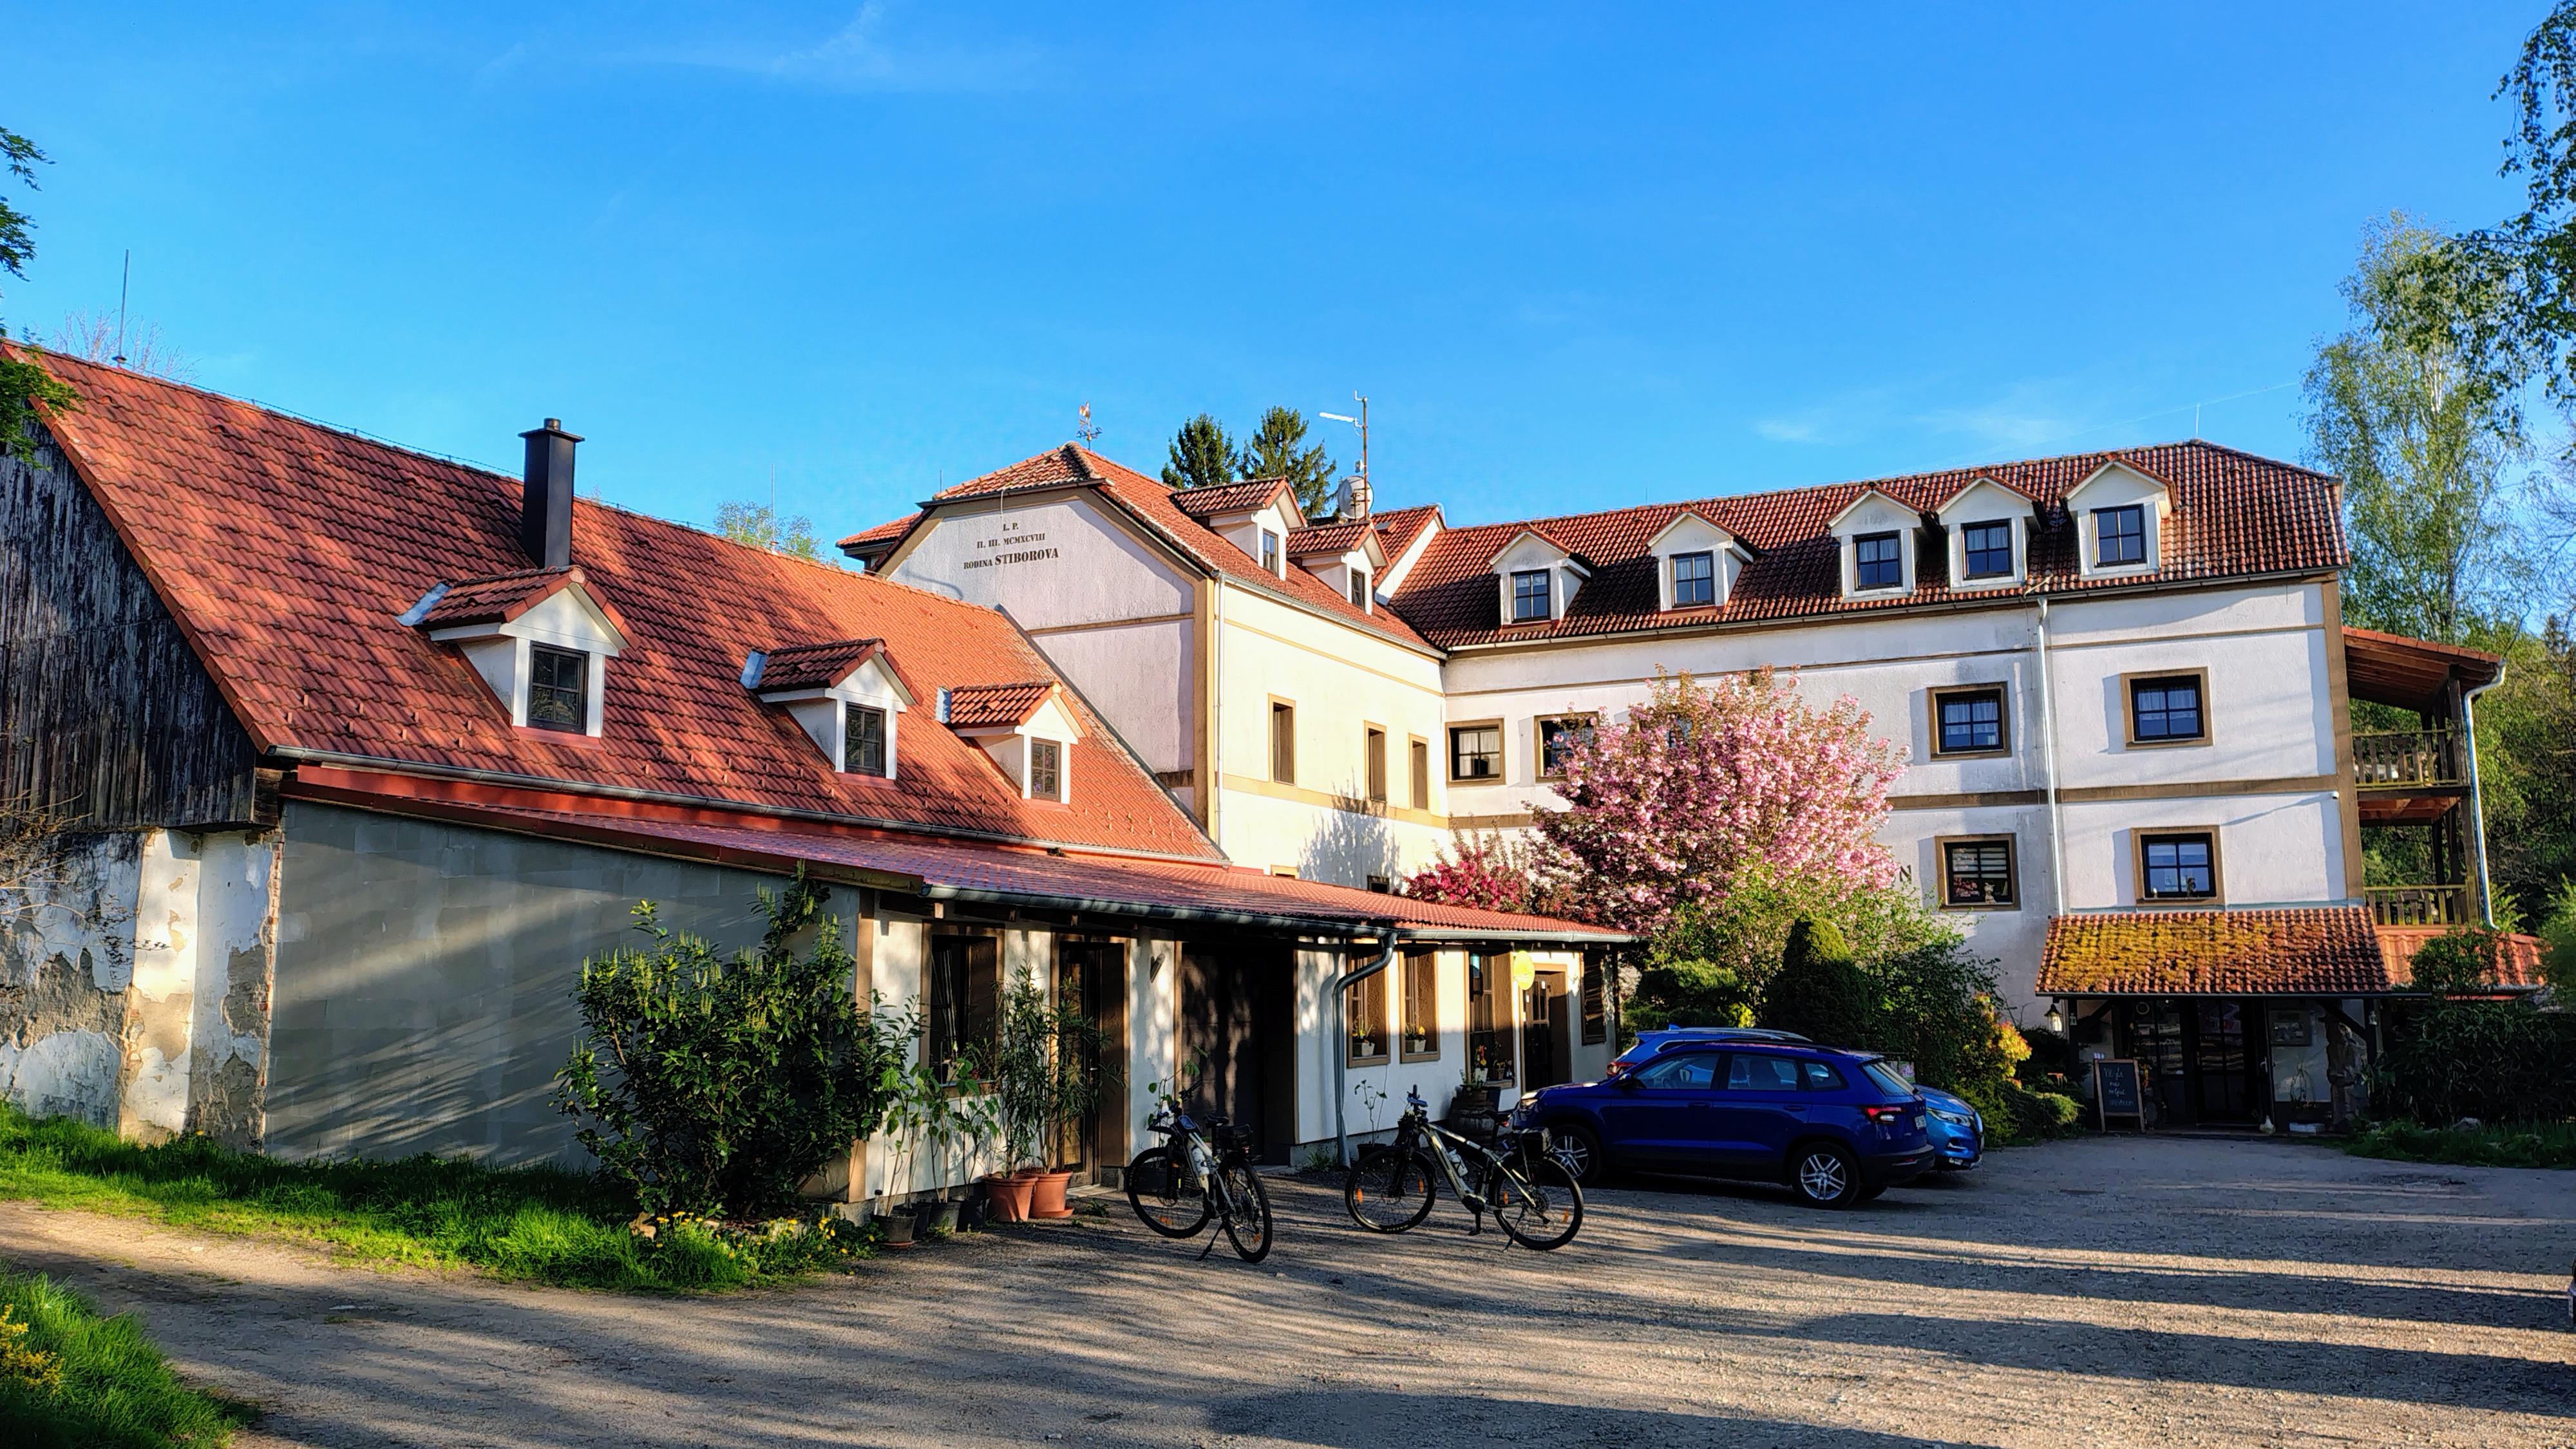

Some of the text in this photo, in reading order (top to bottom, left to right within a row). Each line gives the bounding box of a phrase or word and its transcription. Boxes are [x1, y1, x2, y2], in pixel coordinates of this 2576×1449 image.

[989, 539, 1000, 547] III.
[1003, 533, 1045, 545] MCMXCVIII
[963, 547, 1059, 569] RODINA STIBOROVA
